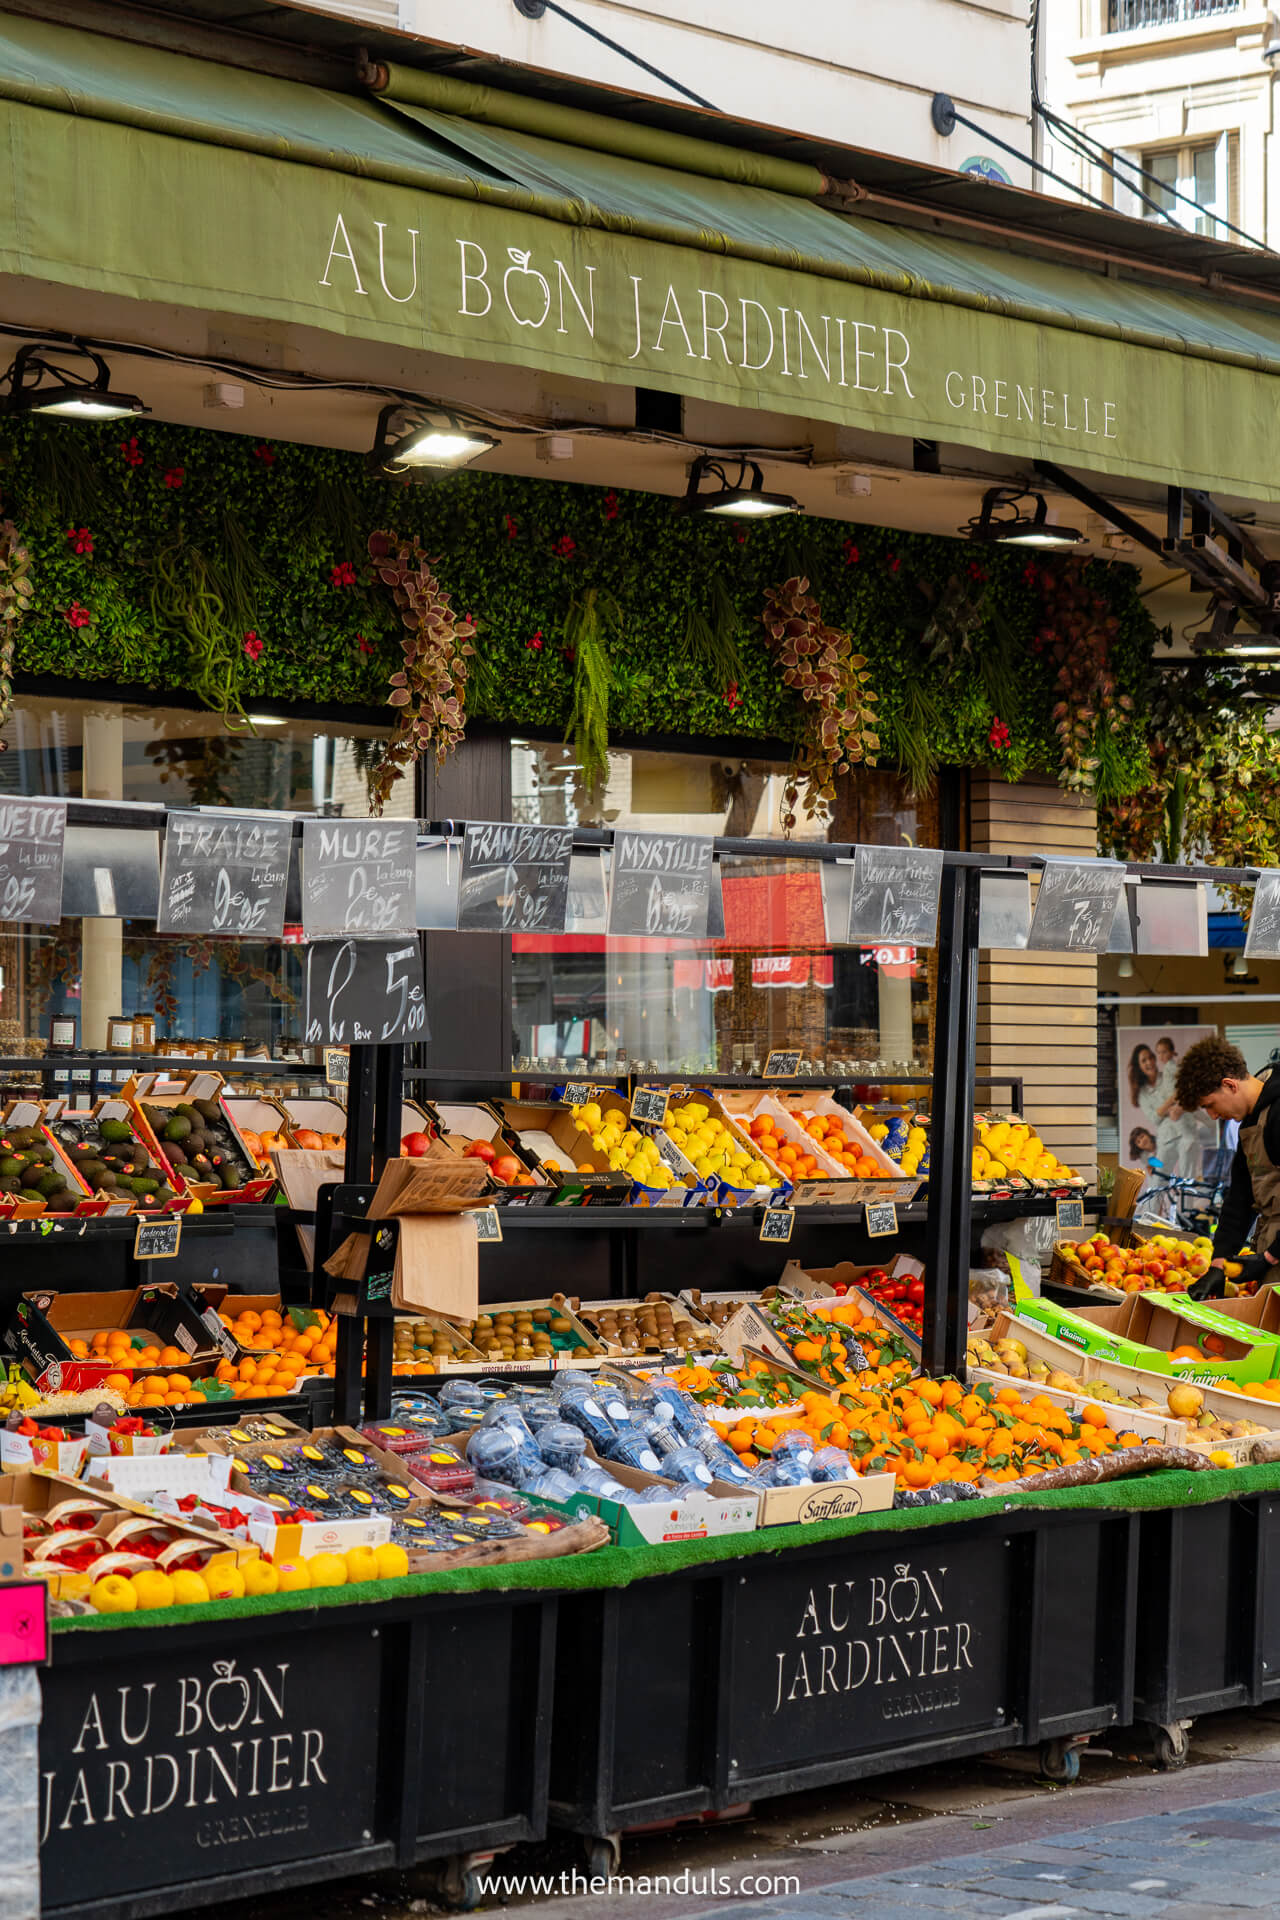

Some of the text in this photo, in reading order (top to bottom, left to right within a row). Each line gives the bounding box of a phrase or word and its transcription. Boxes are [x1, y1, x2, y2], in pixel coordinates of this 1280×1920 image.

[318, 213, 1118, 440] AU BON JARDINIER GRENELLE
[319, 828, 404, 861] MURE
[796, 1563, 948, 1638] AU BON
[72, 1660, 290, 1753] AU BON
[773, 1623, 974, 1715] JARDINIER
[40, 1729, 329, 1847] JARDINIER
